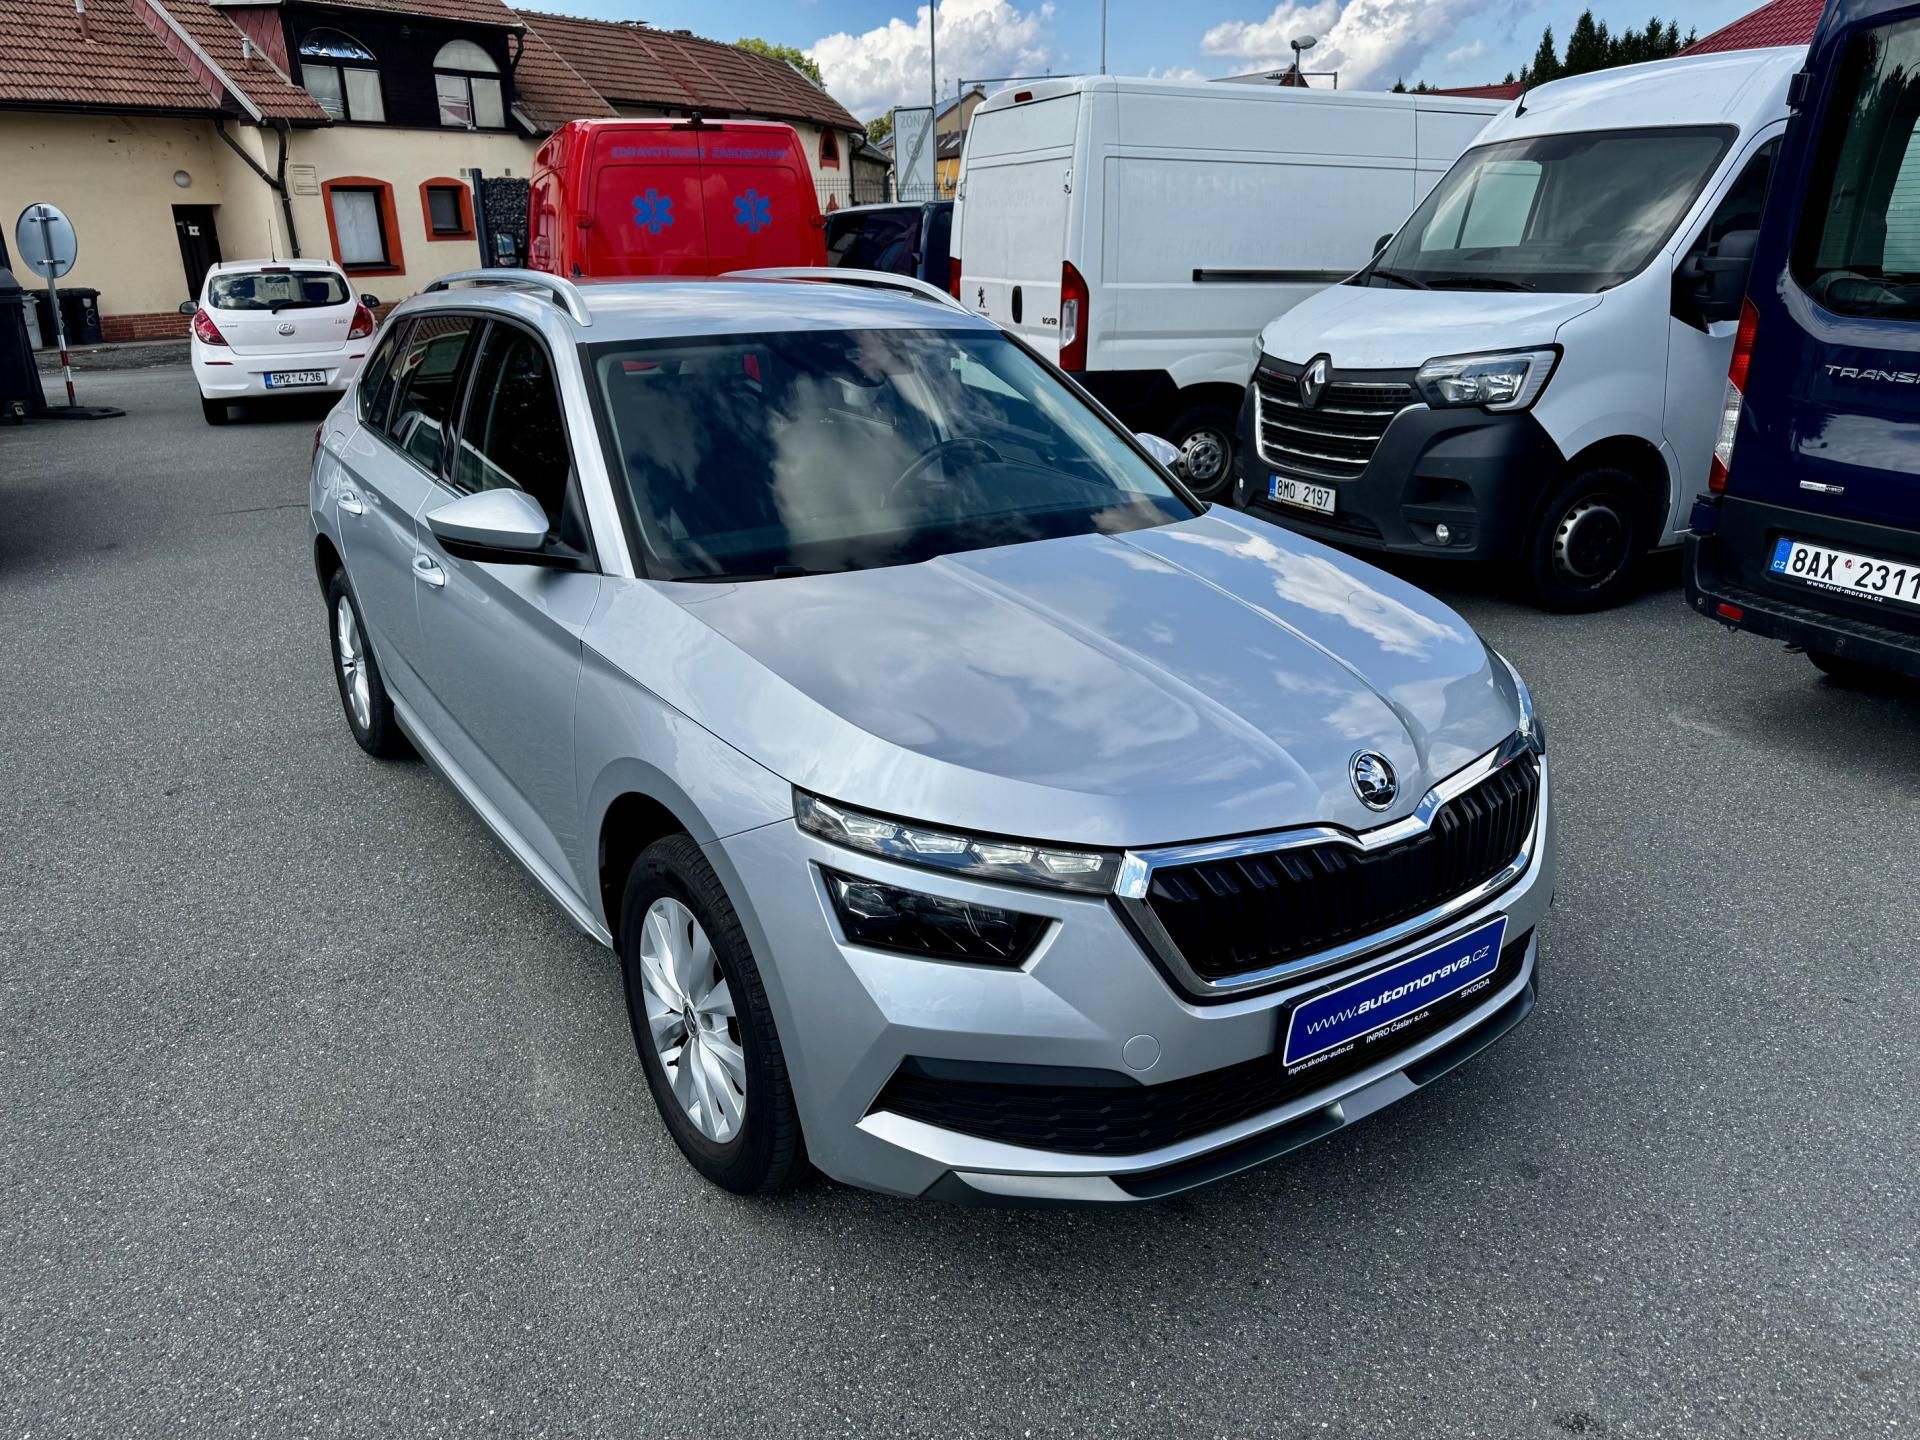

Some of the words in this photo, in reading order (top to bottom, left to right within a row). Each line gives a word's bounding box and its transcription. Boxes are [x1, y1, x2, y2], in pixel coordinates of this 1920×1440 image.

[273, 374, 292, 384] 5M2
[298, 372, 322, 383] 4736
[1824, 364, 1920, 385] TRANS
[1303, 485, 1330, 508] 2197
[1773, 559, 1786, 570] CZ
[1792, 548, 1839, 581] 8AX
[1854, 561, 1920, 600] 2311
[1806, 579, 1885, 603] www.ford-morava.cz
[1306, 944, 1491, 1036] www.automorava.cz
[1366, 1026, 1390, 1045] INPRO
[1391, 1017, 1414, 1033] Čáslav
[1414, 1010, 1430, 1023] s.r.o.
[1287, 1042, 1355, 1076] inpro.skoda-auto.cz
